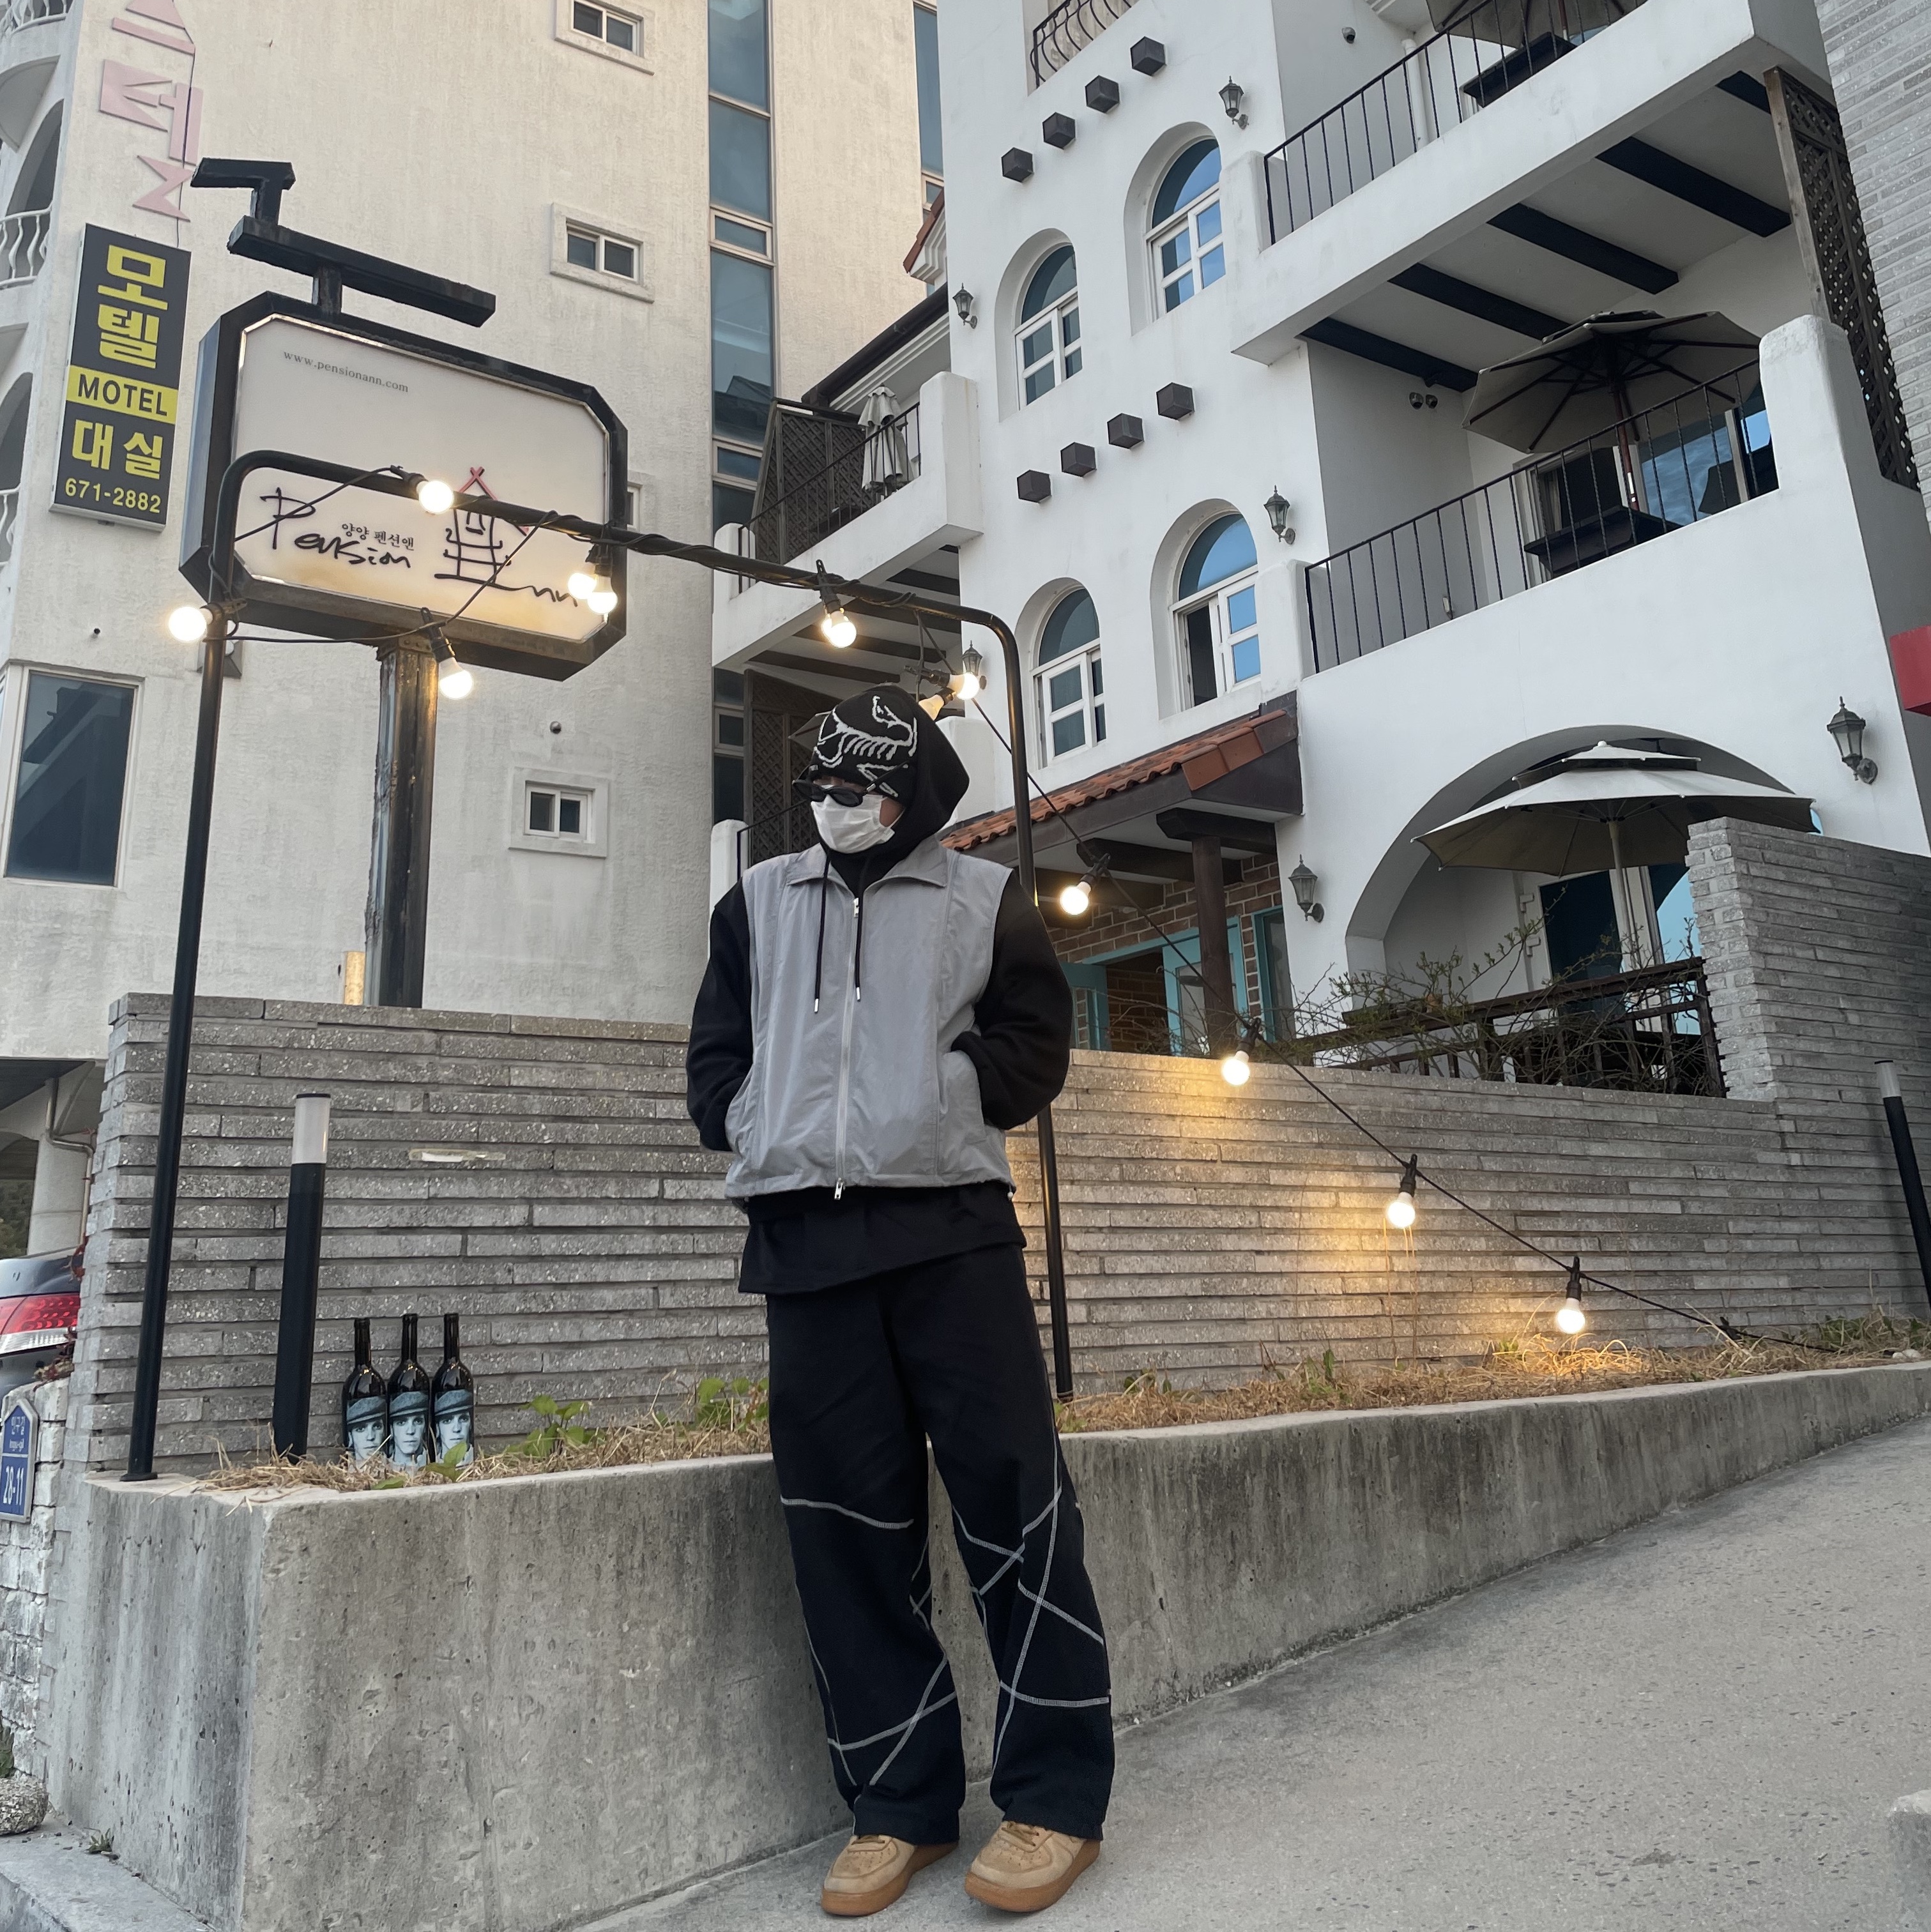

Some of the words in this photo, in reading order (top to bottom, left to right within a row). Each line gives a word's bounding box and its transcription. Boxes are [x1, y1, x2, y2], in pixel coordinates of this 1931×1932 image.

[98, 245, 169, 369] 모텔
[283, 351, 409, 393] www.pensionann.com
[78, 374, 168, 416] MOTEL
[71, 418, 164, 480] 대실
[65, 477, 162, 514] 671-2882
[342, 522, 370, 540] 양양
[374, 530, 415, 551] 펜션앤
[3, 1465, 24, 1506] 28-11
